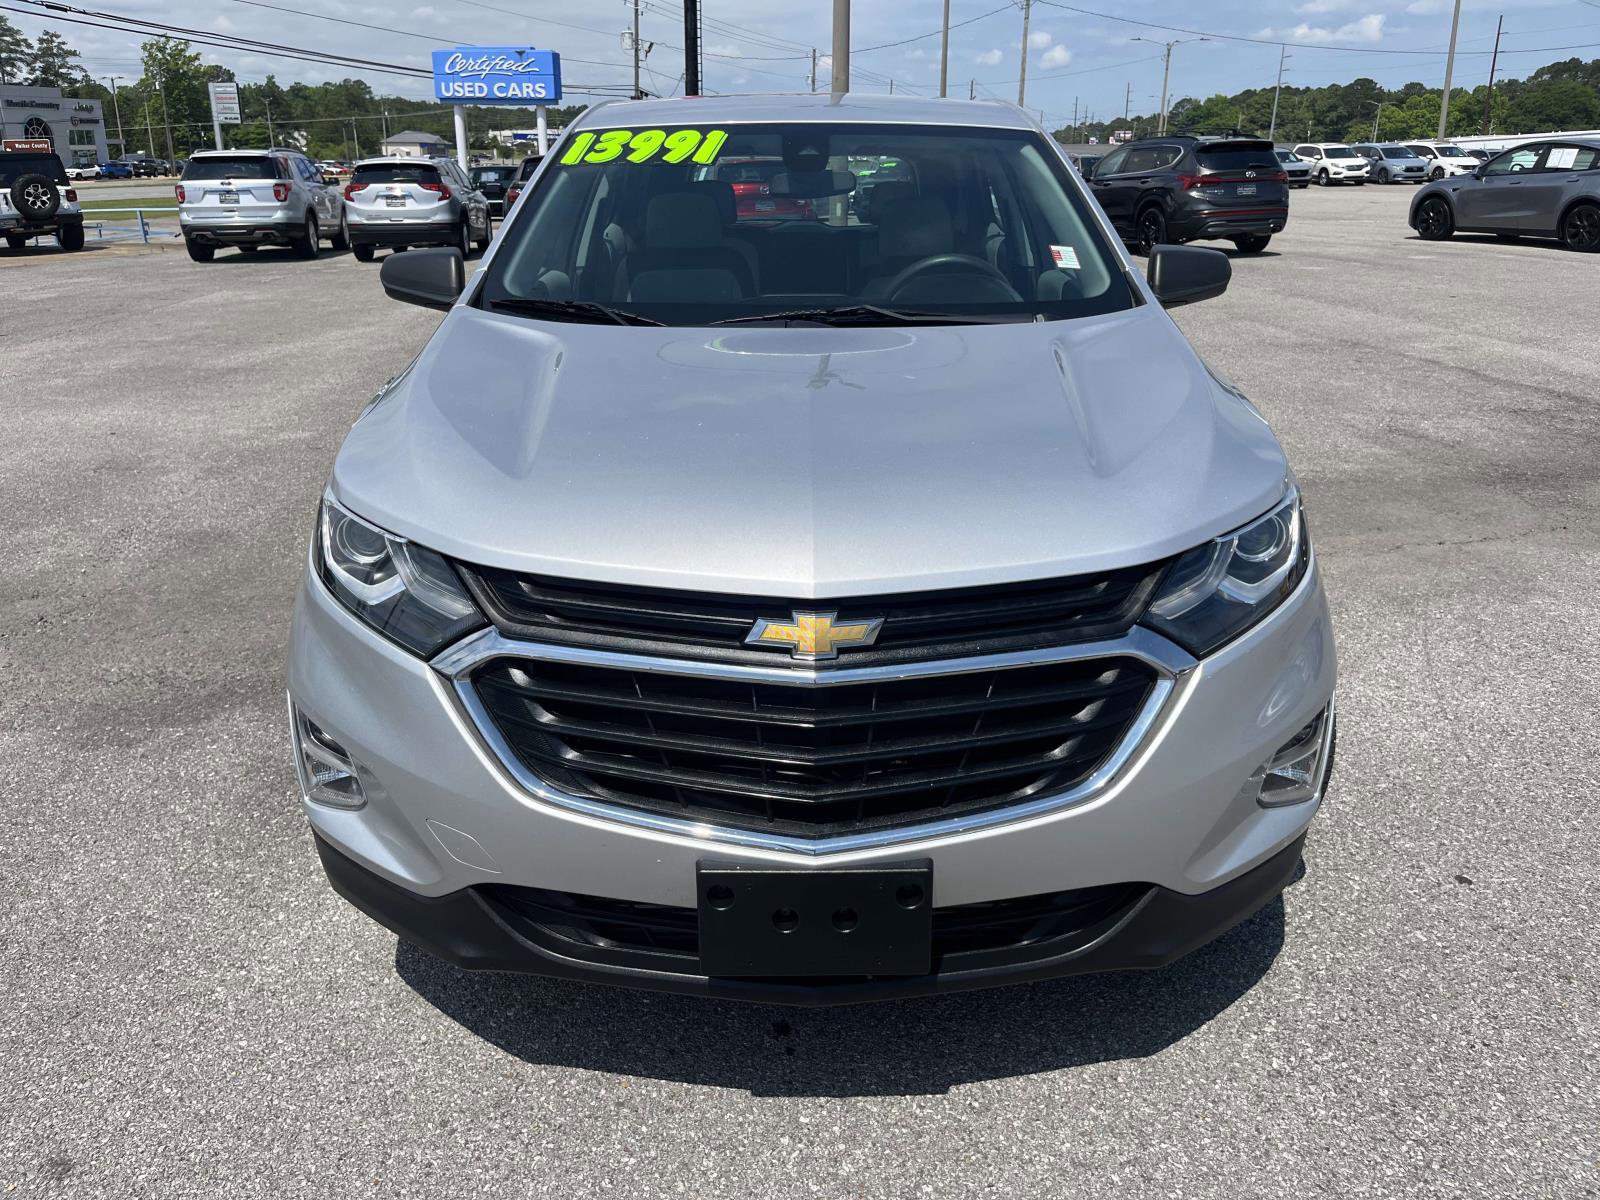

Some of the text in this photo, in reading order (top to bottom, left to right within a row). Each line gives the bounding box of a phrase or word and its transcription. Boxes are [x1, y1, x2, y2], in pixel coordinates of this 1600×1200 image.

[445, 53, 540, 79] Certified
[441, 82, 546, 98] USED CARS
[560, 129, 728, 165] 13991
